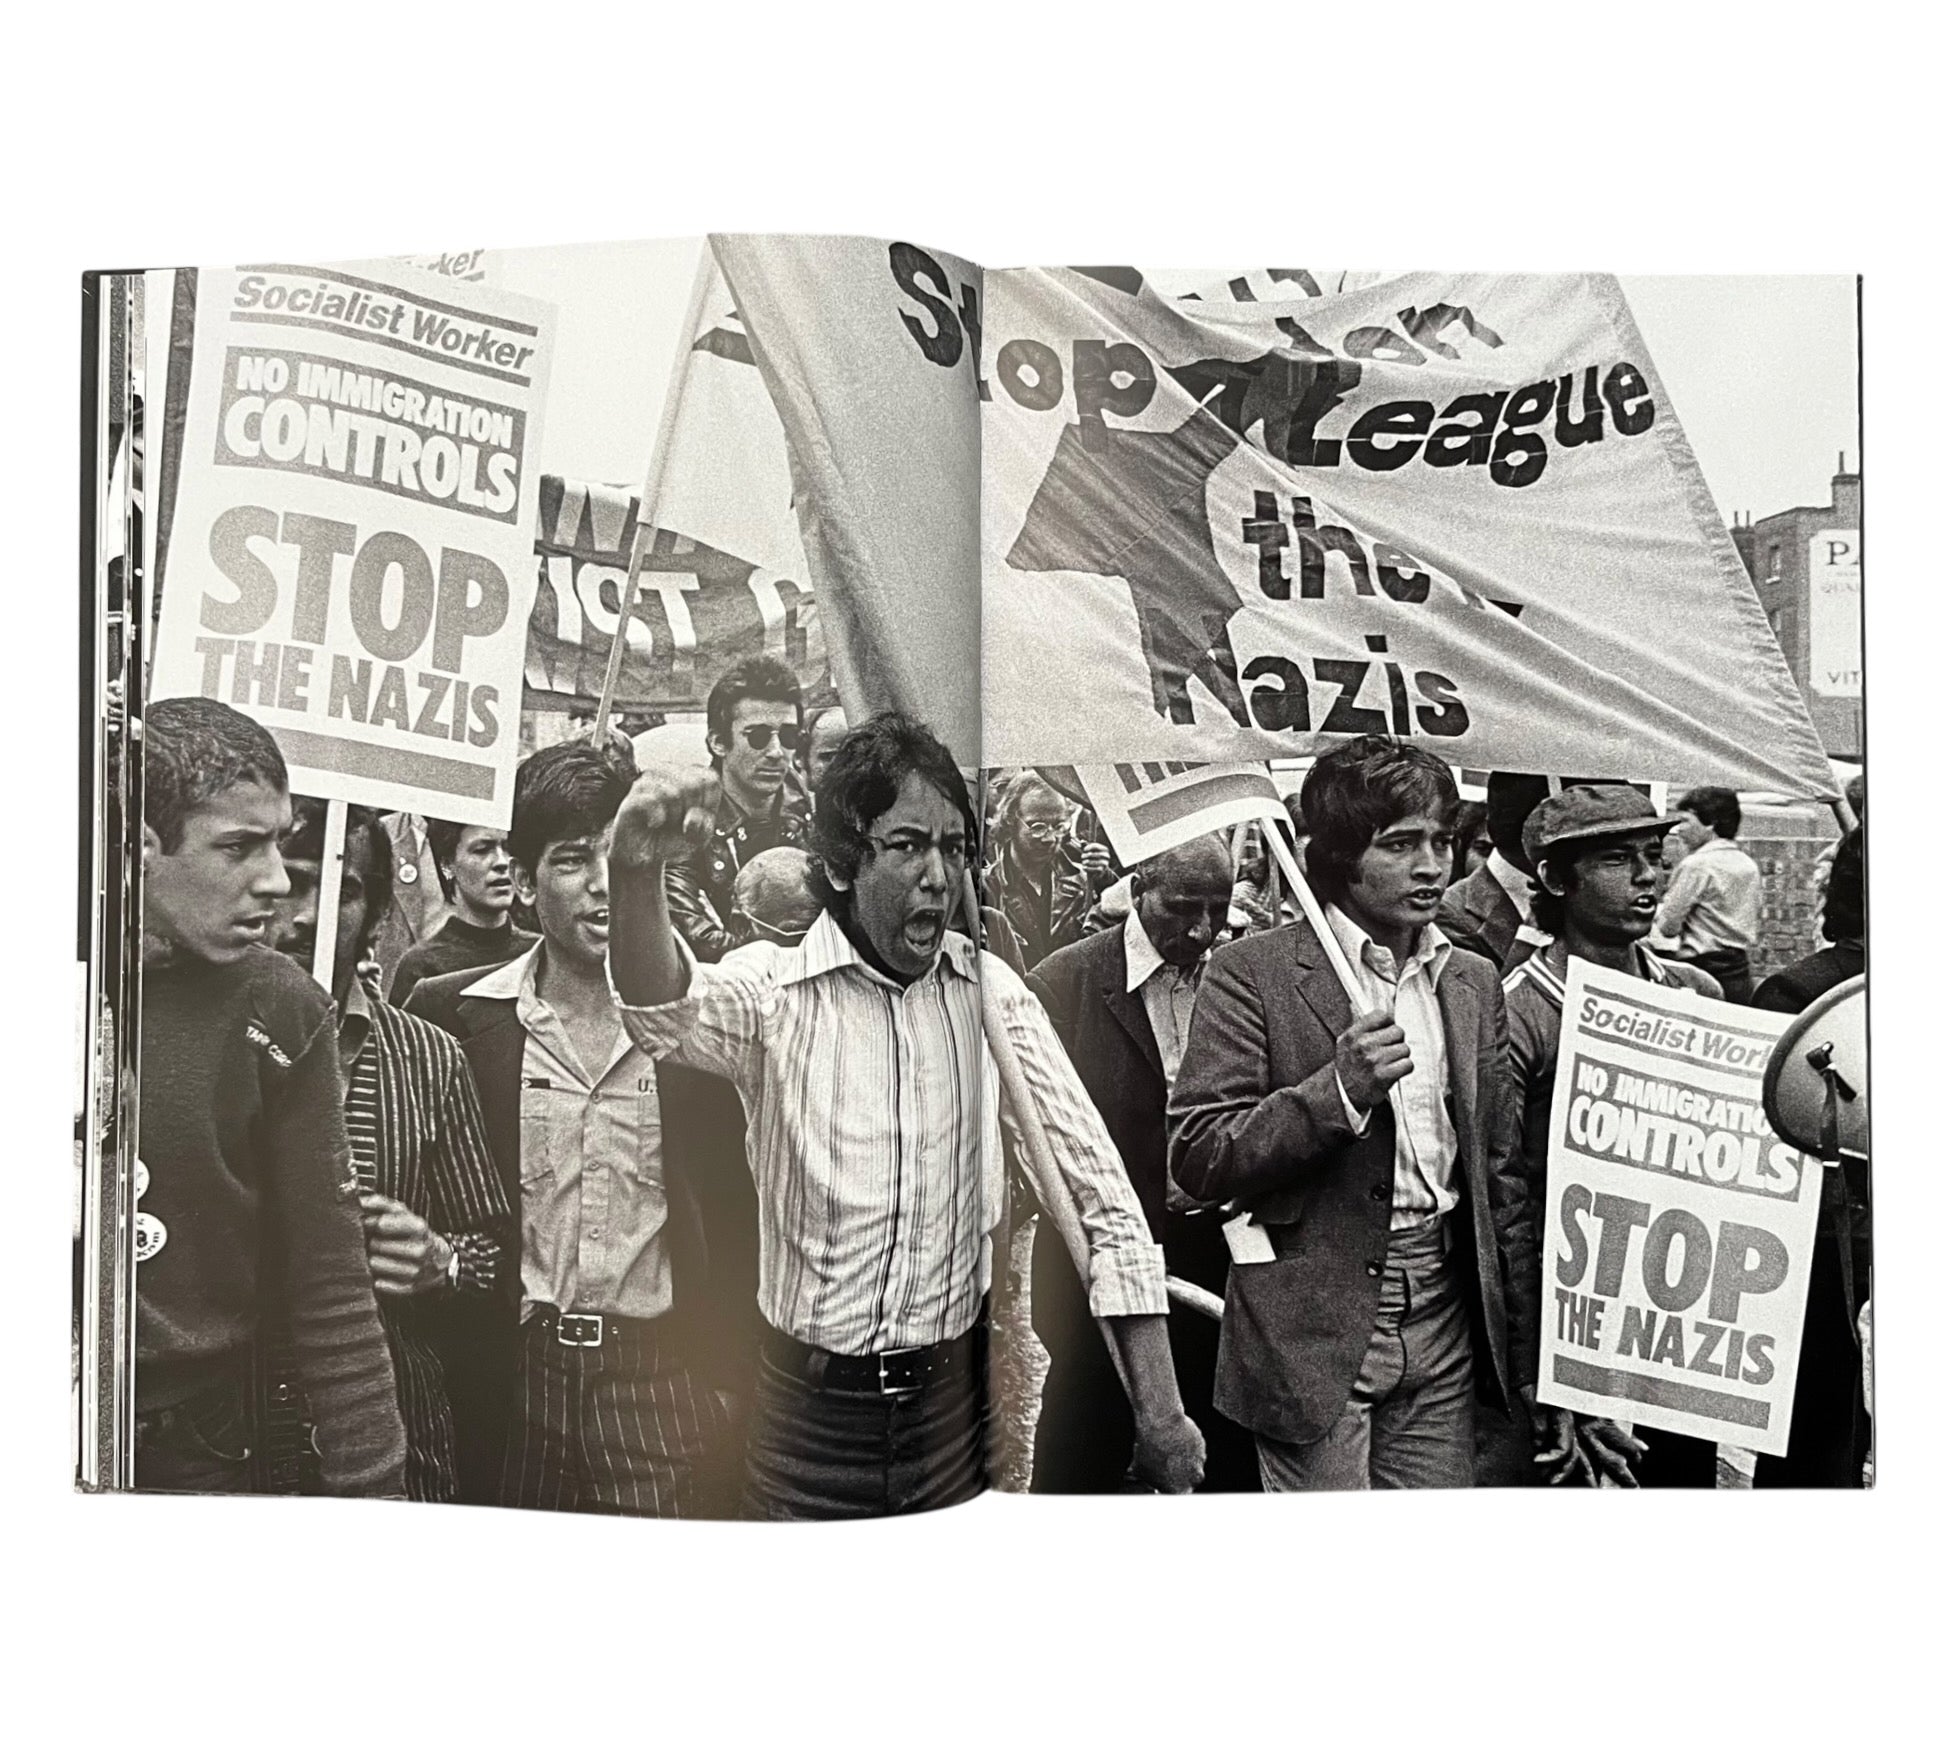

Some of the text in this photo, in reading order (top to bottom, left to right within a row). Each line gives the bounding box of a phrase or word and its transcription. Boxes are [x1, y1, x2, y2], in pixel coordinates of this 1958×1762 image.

[234, 276, 534, 369] Socialist Worker
[236, 356, 513, 448] NO IMMIGRATION
[1286, 361, 1655, 488] League
[224, 396, 517, 513] CONTROLS
[200, 505, 509, 673] STOP
[196, 637, 313, 713] THE
[328, 654, 499, 748] NAZIS
[1145, 607, 1470, 737] Nazis
[1580, 997, 1697, 1052] Socialist
[1570, 1095, 1799, 1193] CONTROLS
[1577, 1062, 1778, 1138] NO IMMIGRATIO
[1556, 1183, 1789, 1323] STOP
[1555, 1288, 1775, 1386] THE NAZIS
